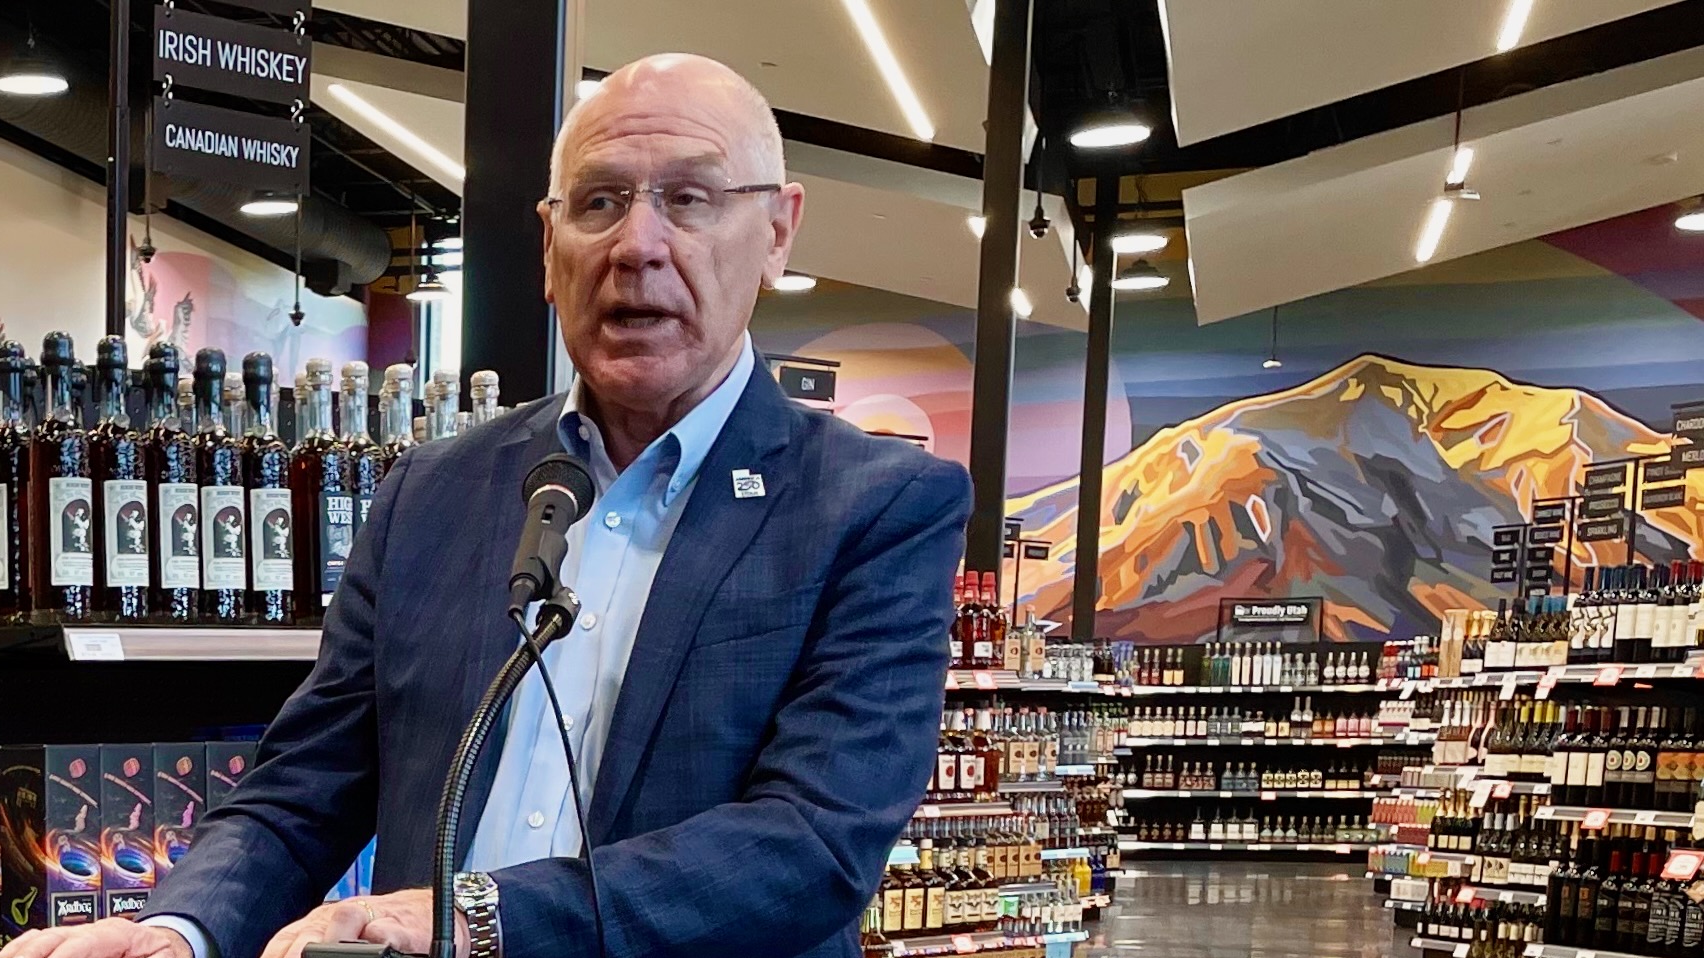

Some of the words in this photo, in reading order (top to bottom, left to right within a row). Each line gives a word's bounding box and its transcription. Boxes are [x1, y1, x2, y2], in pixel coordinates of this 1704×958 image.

[158, 30, 212, 67] IRISH
[217, 40, 306, 84] WHISKEY
[165, 124, 238, 158] CANADIAN
[242, 137, 299, 168] WHISKY
[801, 377, 815, 391] GIN
[1676, 418, 1704, 432] CHARDO
[1682, 450, 1704, 462] MERLO
[326, 496, 353, 511] HIG
[327, 511, 353, 524] WES
[1252, 605, 1286, 617] Proudly
[1287, 605, 1308, 615] Utah
